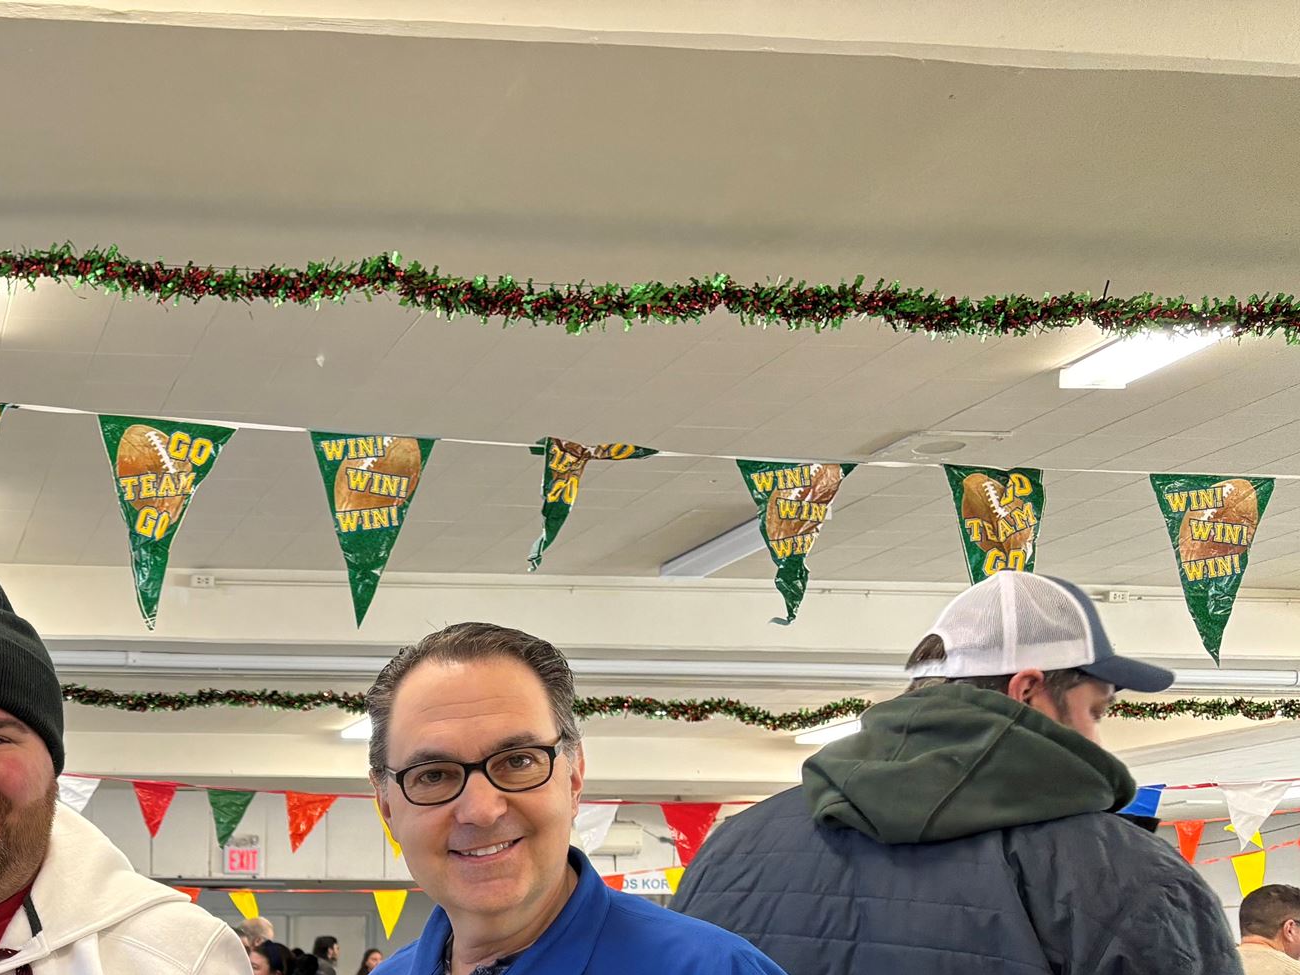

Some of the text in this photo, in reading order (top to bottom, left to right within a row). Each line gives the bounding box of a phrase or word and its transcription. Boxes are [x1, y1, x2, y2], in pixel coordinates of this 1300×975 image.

[168, 430, 212, 467] GO
[321, 436, 384, 461] WIN!
[121, 472, 196, 501] TEAM
[347, 468, 409, 498] WIN!
[751, 465, 811, 492] WIN!
[1165, 488, 1223, 512] WIN!
[135, 506, 170, 541] GO
[336, 506, 399, 532] WIN!
[965, 502, 1037, 543] TEAM
[1190, 519, 1248, 546] WIN!
[983, 548, 1026, 576] GO
[1182, 554, 1241, 582] WIN!
[228, 848, 258, 872] EXIT
